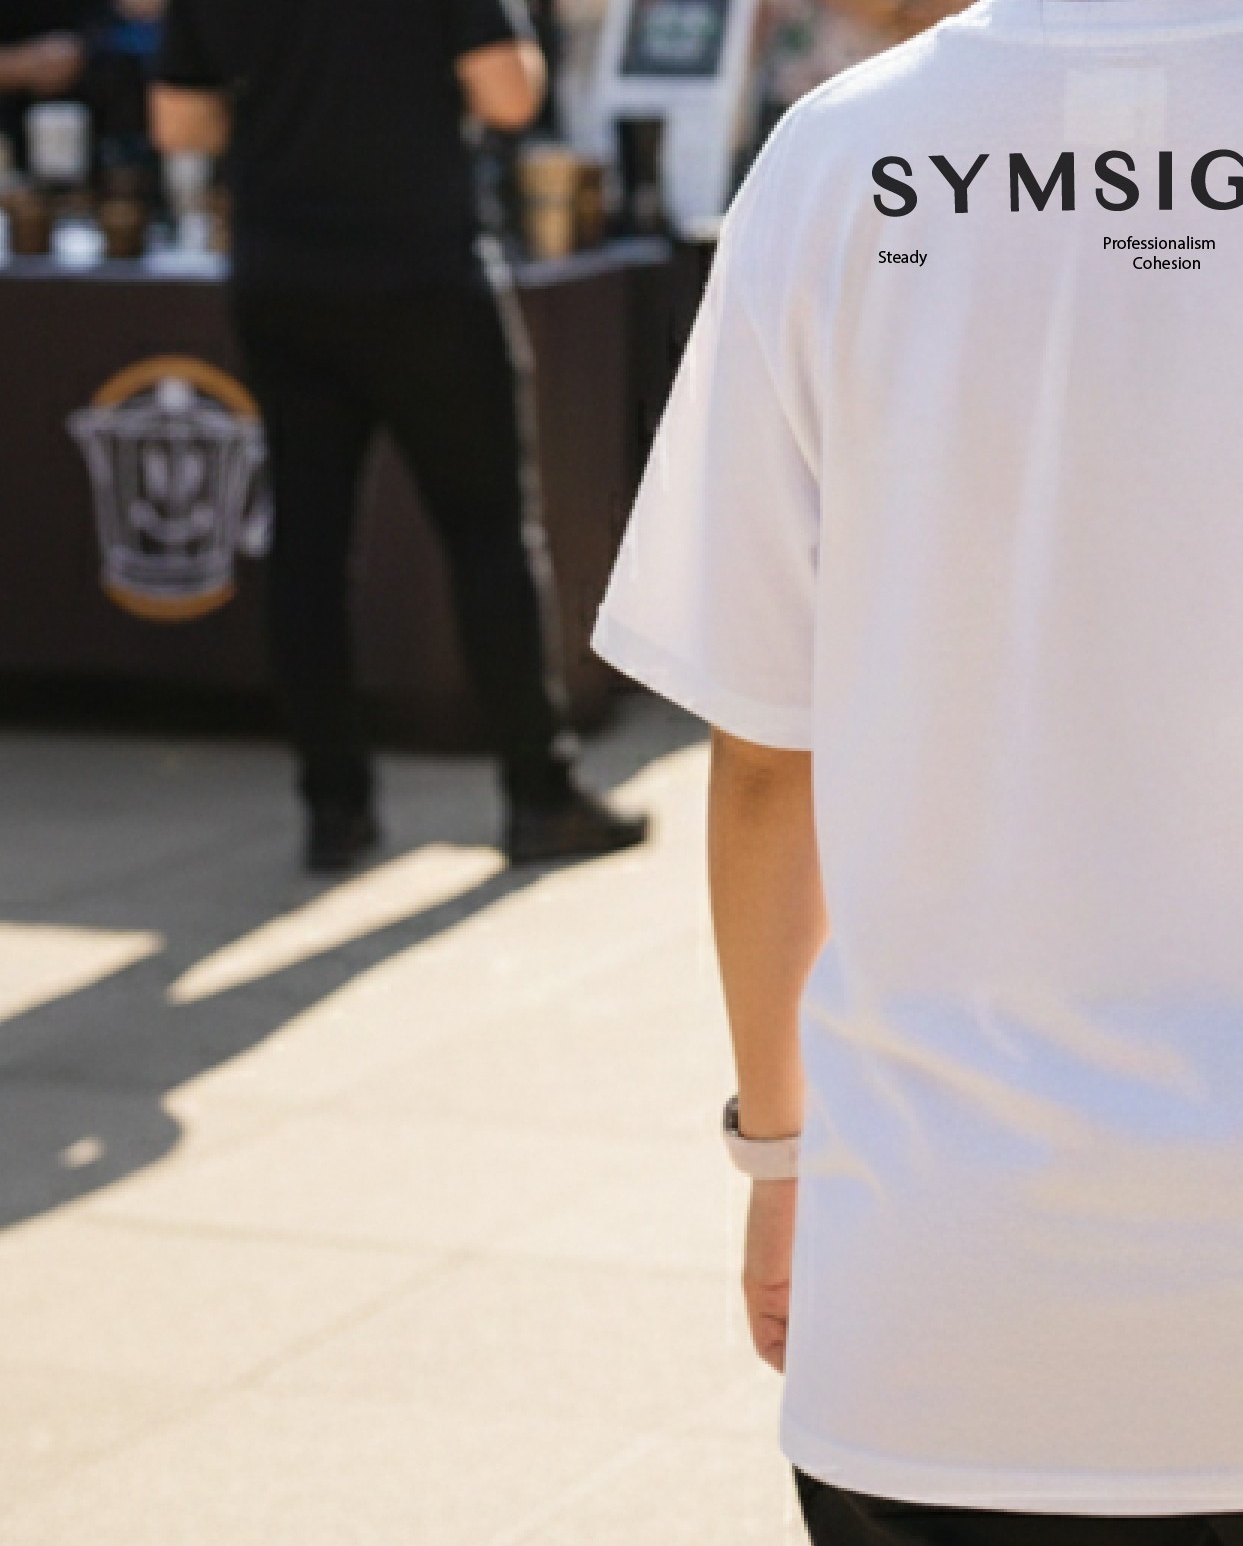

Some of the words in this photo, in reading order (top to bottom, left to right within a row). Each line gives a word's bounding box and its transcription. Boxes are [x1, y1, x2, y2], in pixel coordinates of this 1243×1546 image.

[1102, 235, 1216, 250] Professionalism
[878, 249, 928, 268] Steady
[1132, 255, 1201, 270] Cohesion
